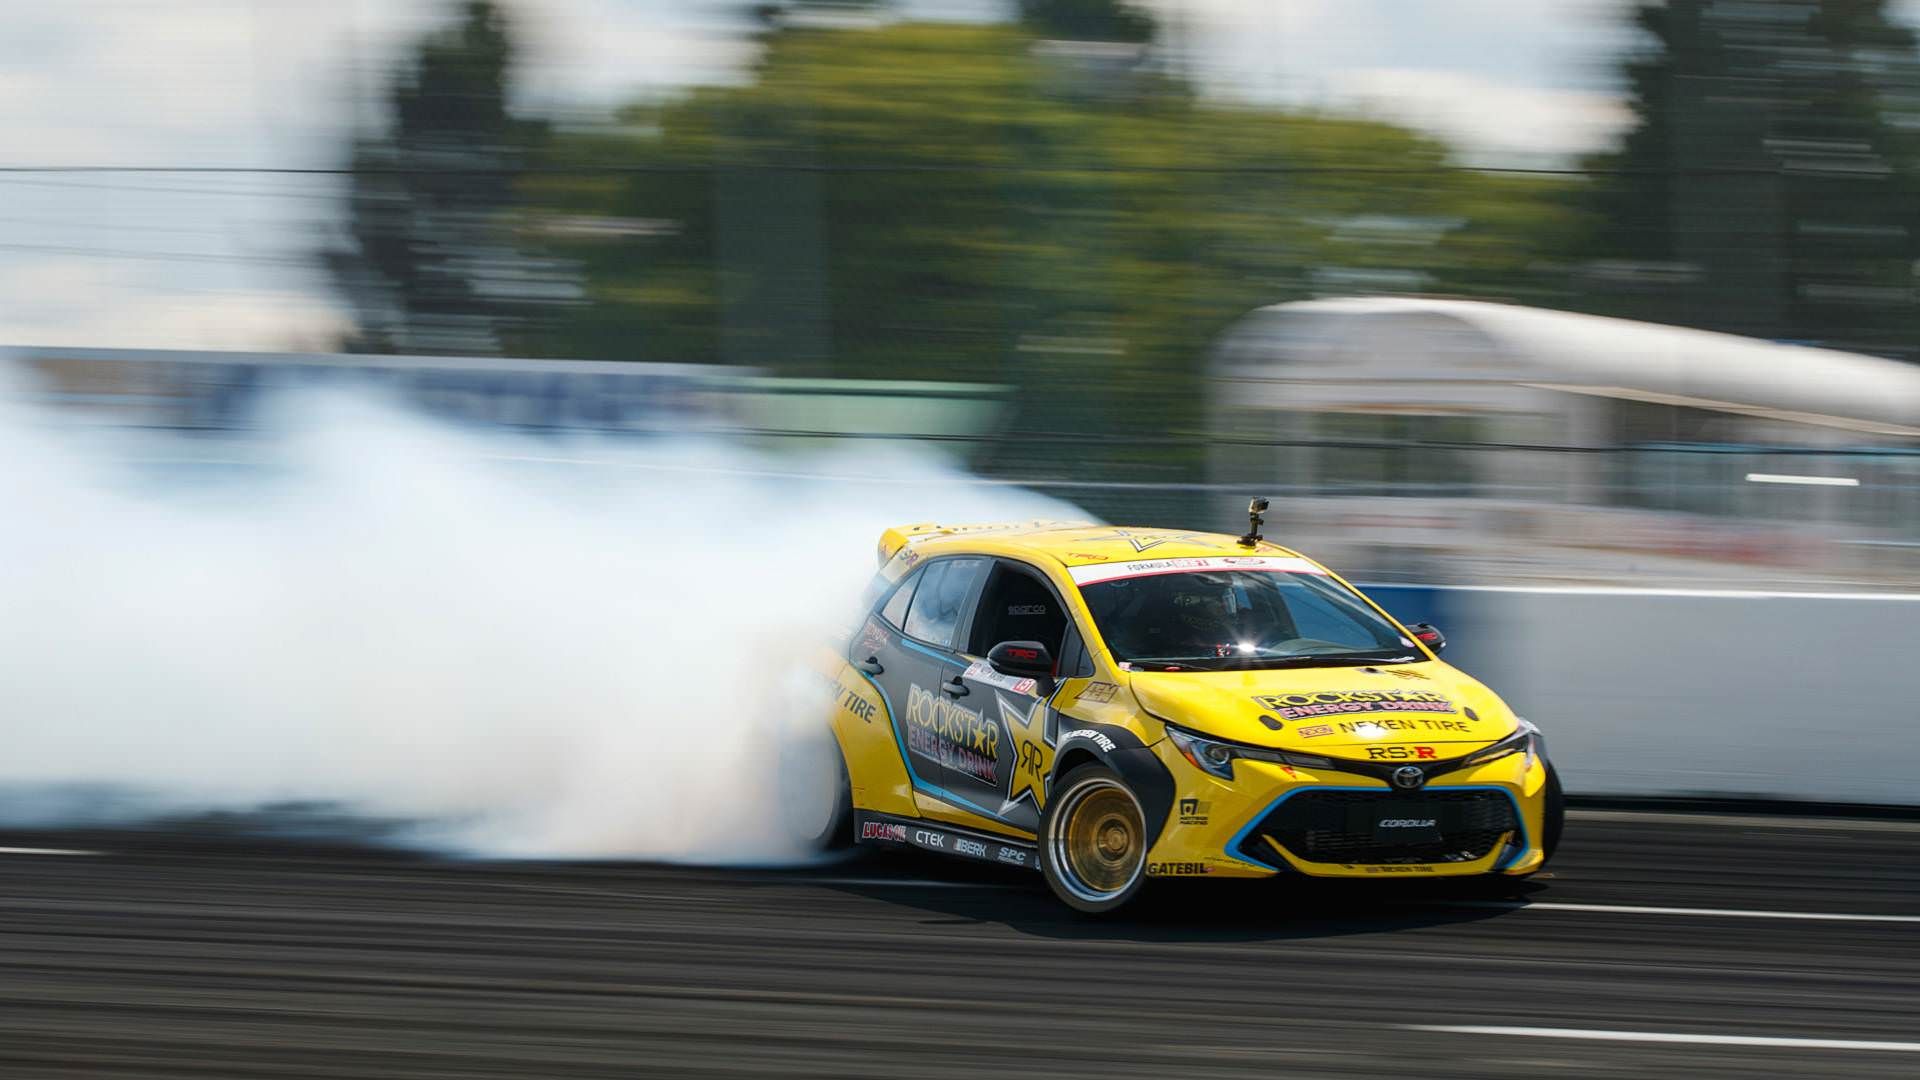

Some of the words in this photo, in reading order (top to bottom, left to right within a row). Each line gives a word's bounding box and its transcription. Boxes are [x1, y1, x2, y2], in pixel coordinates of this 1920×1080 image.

[1007, 649, 1037, 659] TRD
[844, 691, 876, 723] TIRE
[1280, 702, 1373, 718] ENERGY
[1380, 701, 1450, 711] DRINK
[1418, 720, 1472, 733] TIRE
[1092, 732, 1117, 752] TIRE
[910, 727, 956, 767] ENERGY
[958, 747, 998, 783] DRINK
[862, 822, 893, 840] LUCAS
[1378, 819, 1436, 828] COROLLA
[915, 830, 944, 847] CTEK
[999, 847, 1026, 861] SPC
[1148, 862, 1209, 874] GATEBIL
